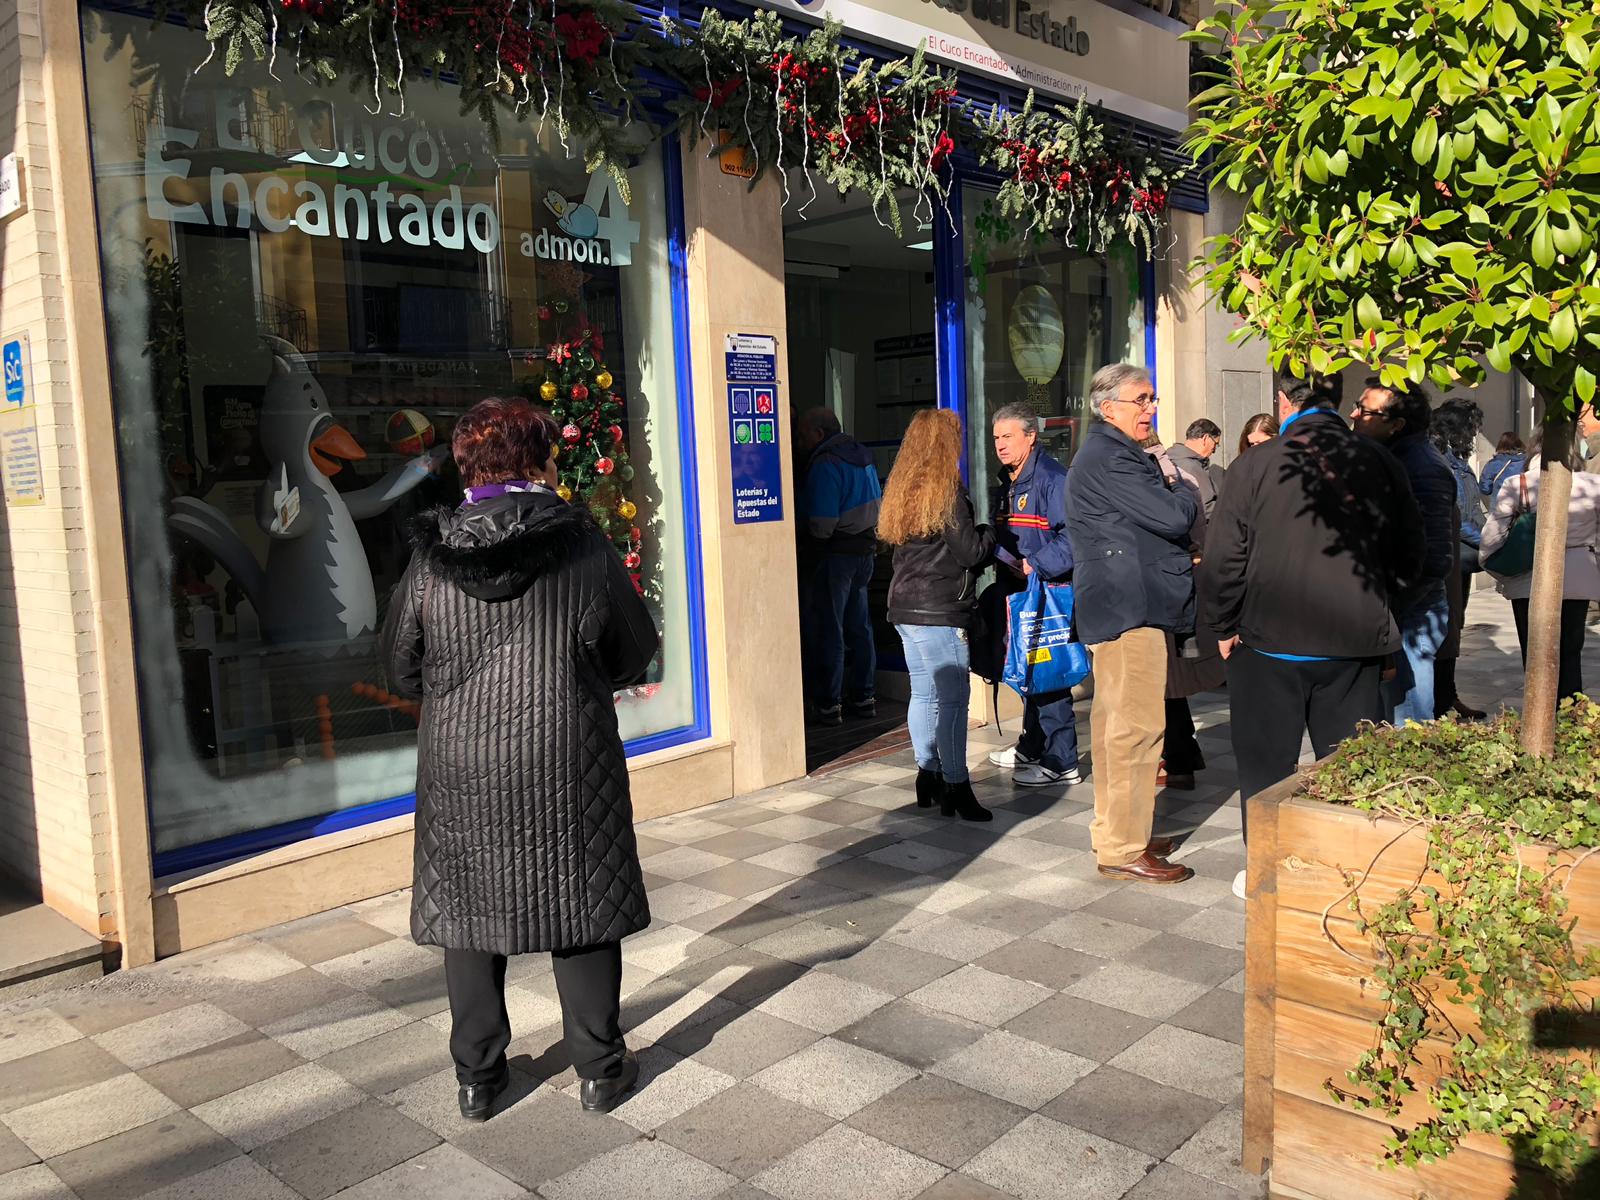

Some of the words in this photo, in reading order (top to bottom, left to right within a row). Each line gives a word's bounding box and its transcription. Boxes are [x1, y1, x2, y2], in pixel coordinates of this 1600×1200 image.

[1016, 0, 1090, 56] Estado
[928, 35, 937, 49] El
[939, 39, 962, 57] Cuco
[964, 47, 1009, 72] Encantado
[1015, 64, 1072, 92] Administración
[298, 98, 440, 179] Cuco
[145, 125, 499, 254] Encantado
[582, 160, 641, 266] 4
[520, 227, 610, 265] admon.
[736, 487, 763, 497] Loterías
[764, 488, 769, 497] y
[737, 499, 767, 509] Apuestas
[767, 496, 778, 505] del
[737, 509, 760, 518] Estado
